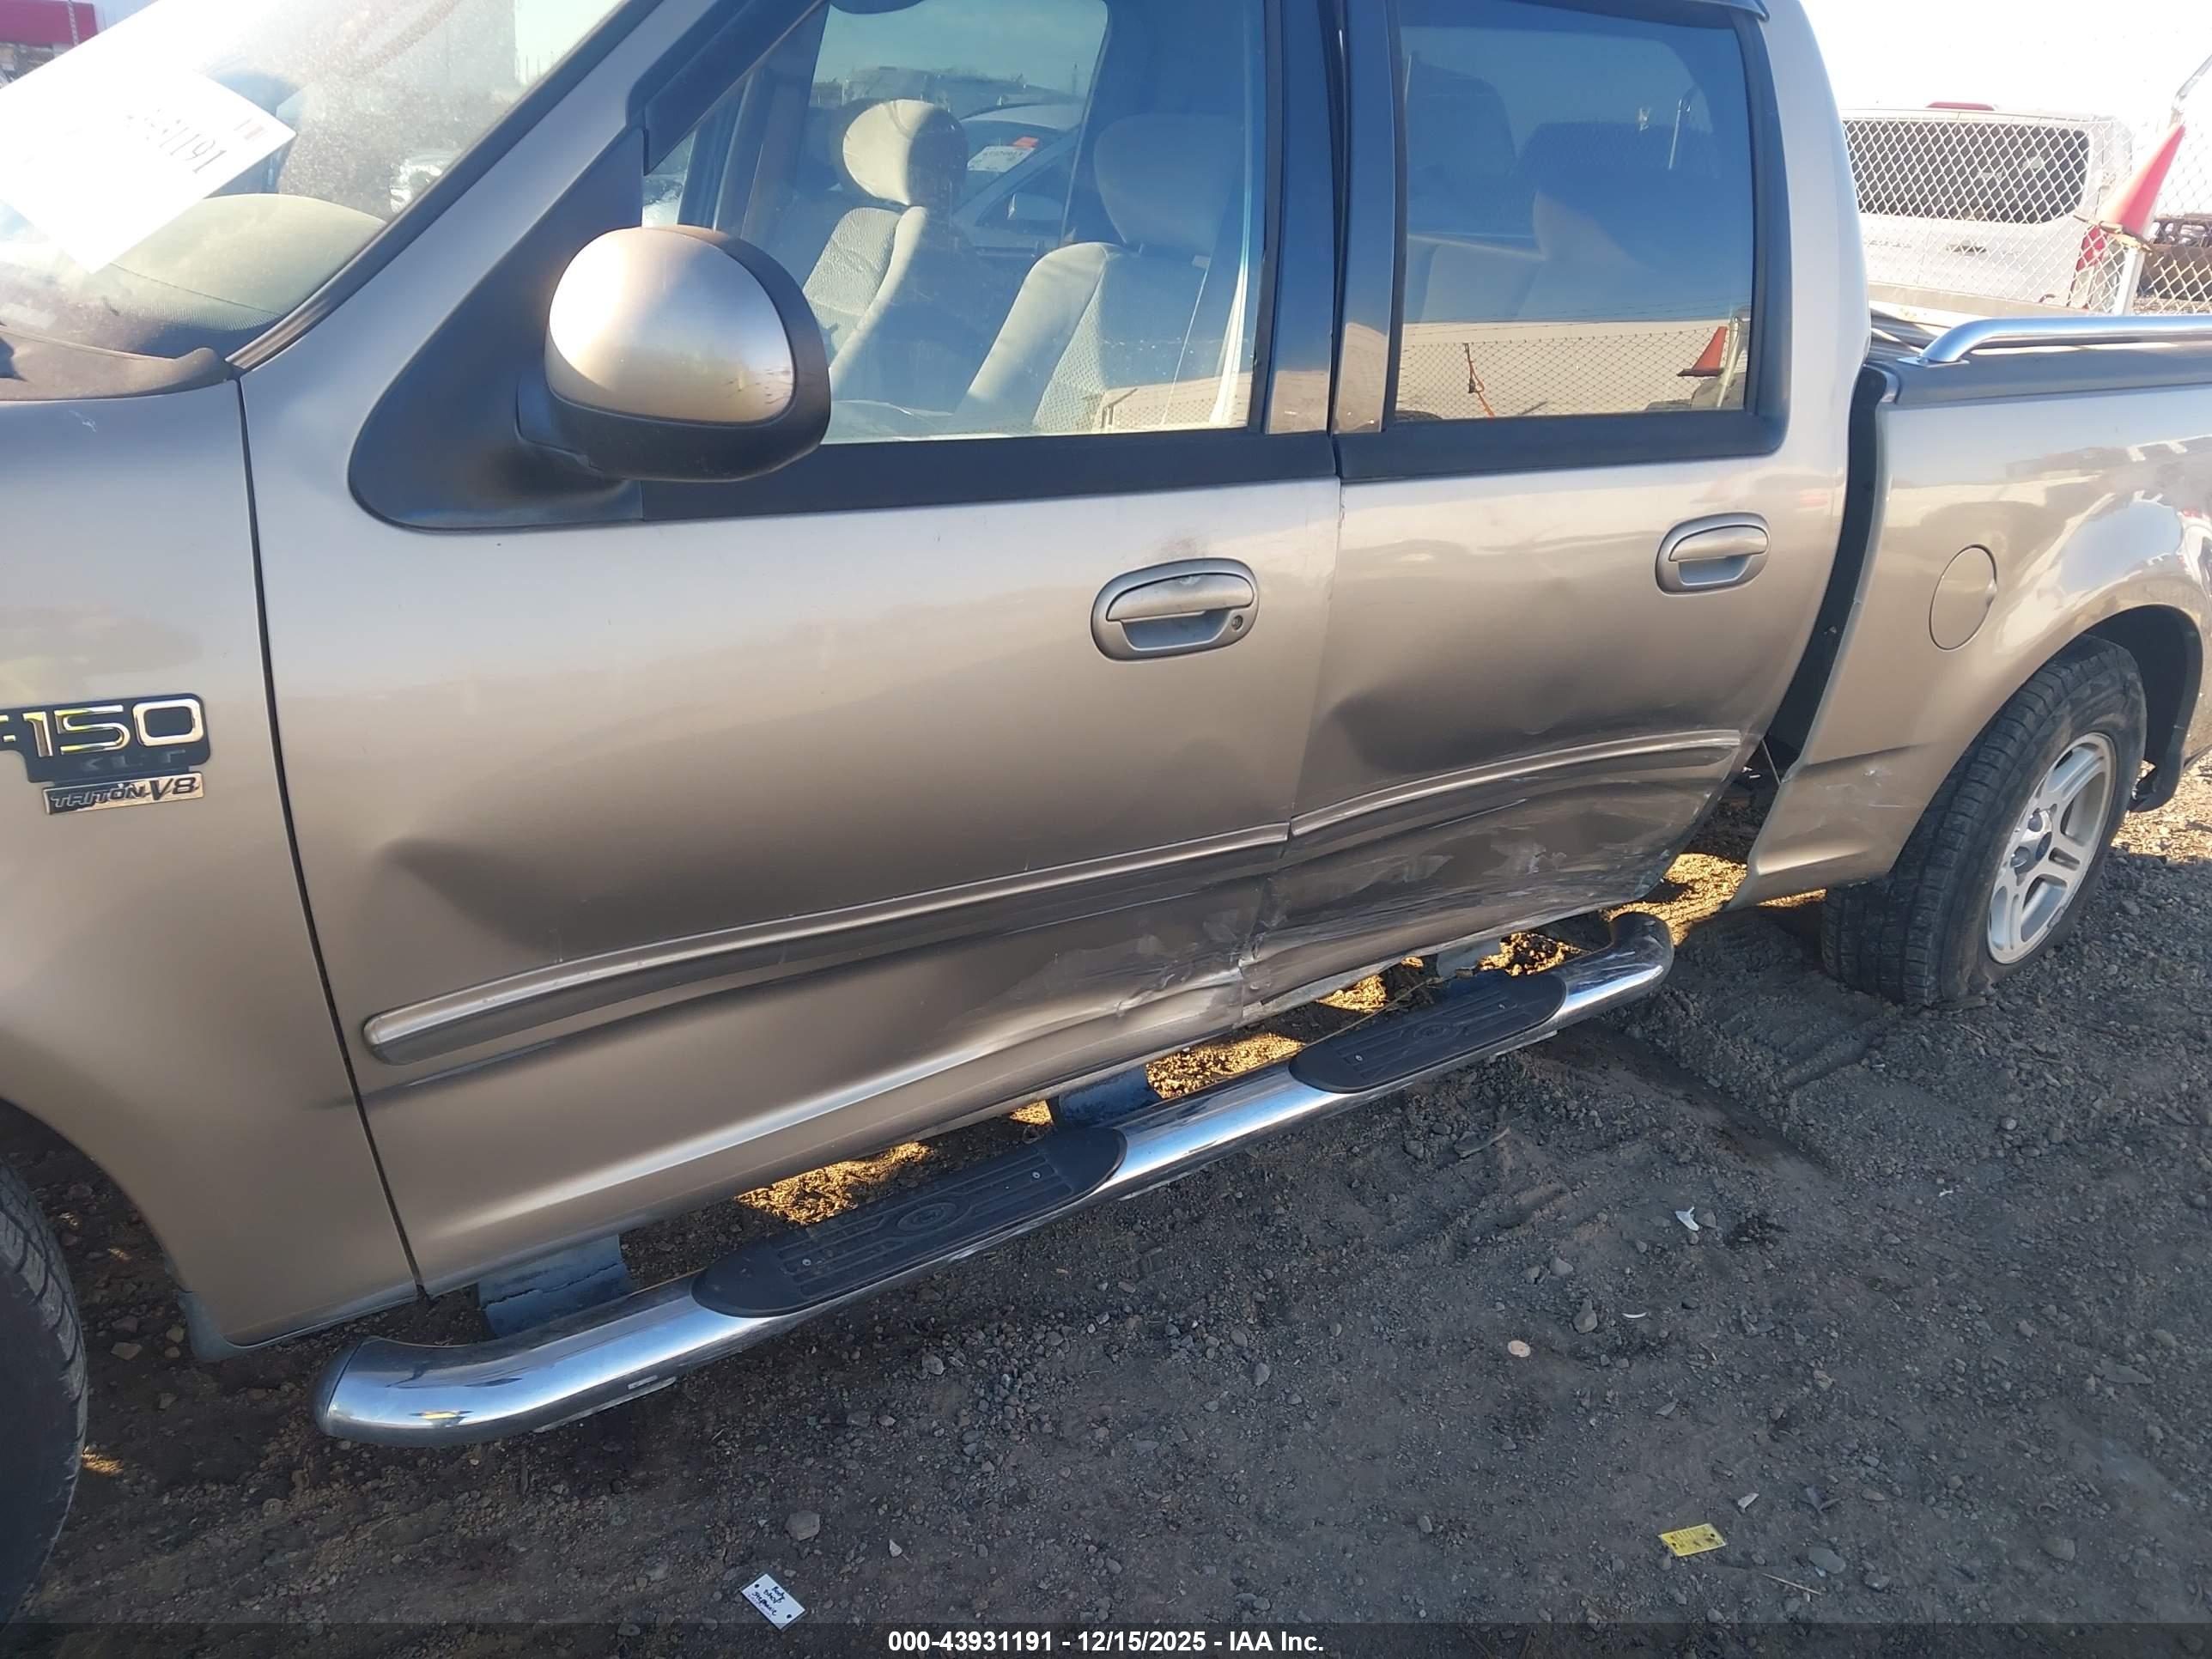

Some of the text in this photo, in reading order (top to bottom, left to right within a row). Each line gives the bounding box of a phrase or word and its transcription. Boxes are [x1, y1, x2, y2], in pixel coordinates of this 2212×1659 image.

[0, 698, 204, 757] -150
[51, 776, 200, 808] TRITON V8
